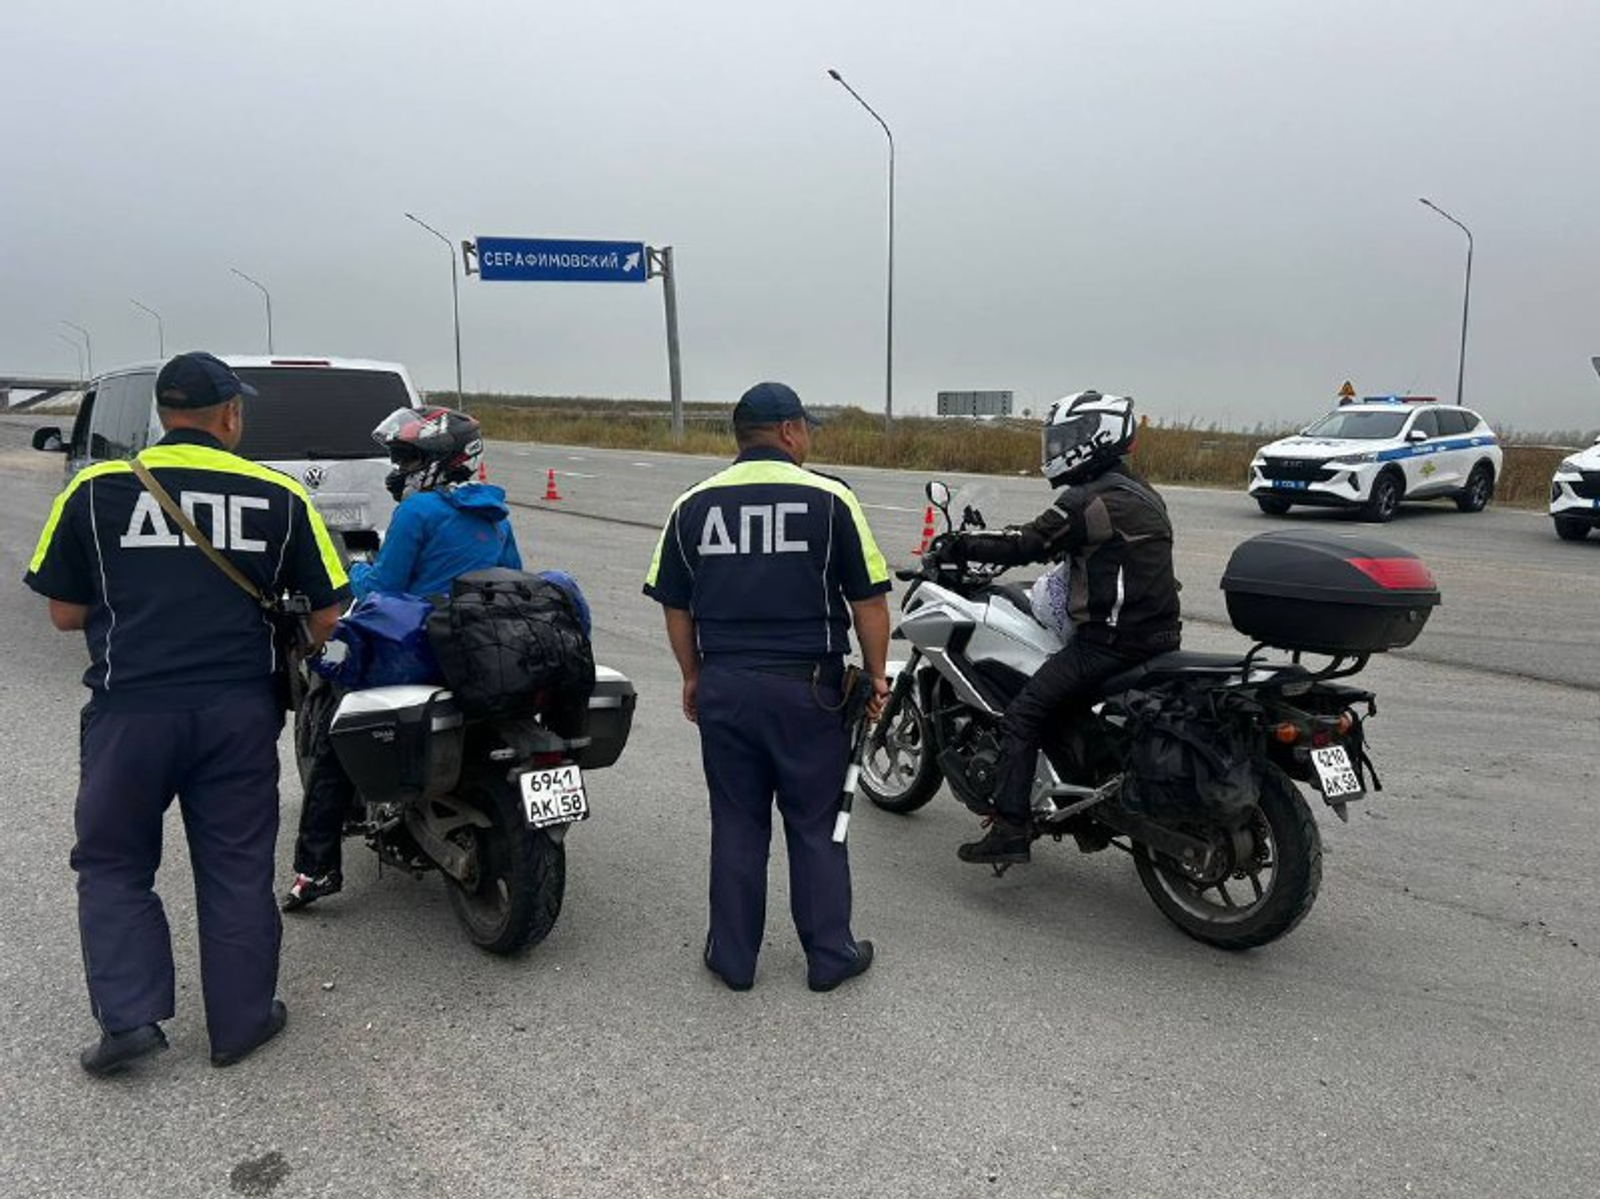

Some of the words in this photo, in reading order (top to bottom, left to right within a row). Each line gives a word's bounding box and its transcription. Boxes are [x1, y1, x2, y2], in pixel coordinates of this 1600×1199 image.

[484, 252, 618, 268] СЕРАФИМОВСКИЙ
[120, 491, 269, 552] ДПС
[697, 503, 808, 555] ДПС
[531, 769, 573, 792] 6941
[561, 794, 581, 812] 58
